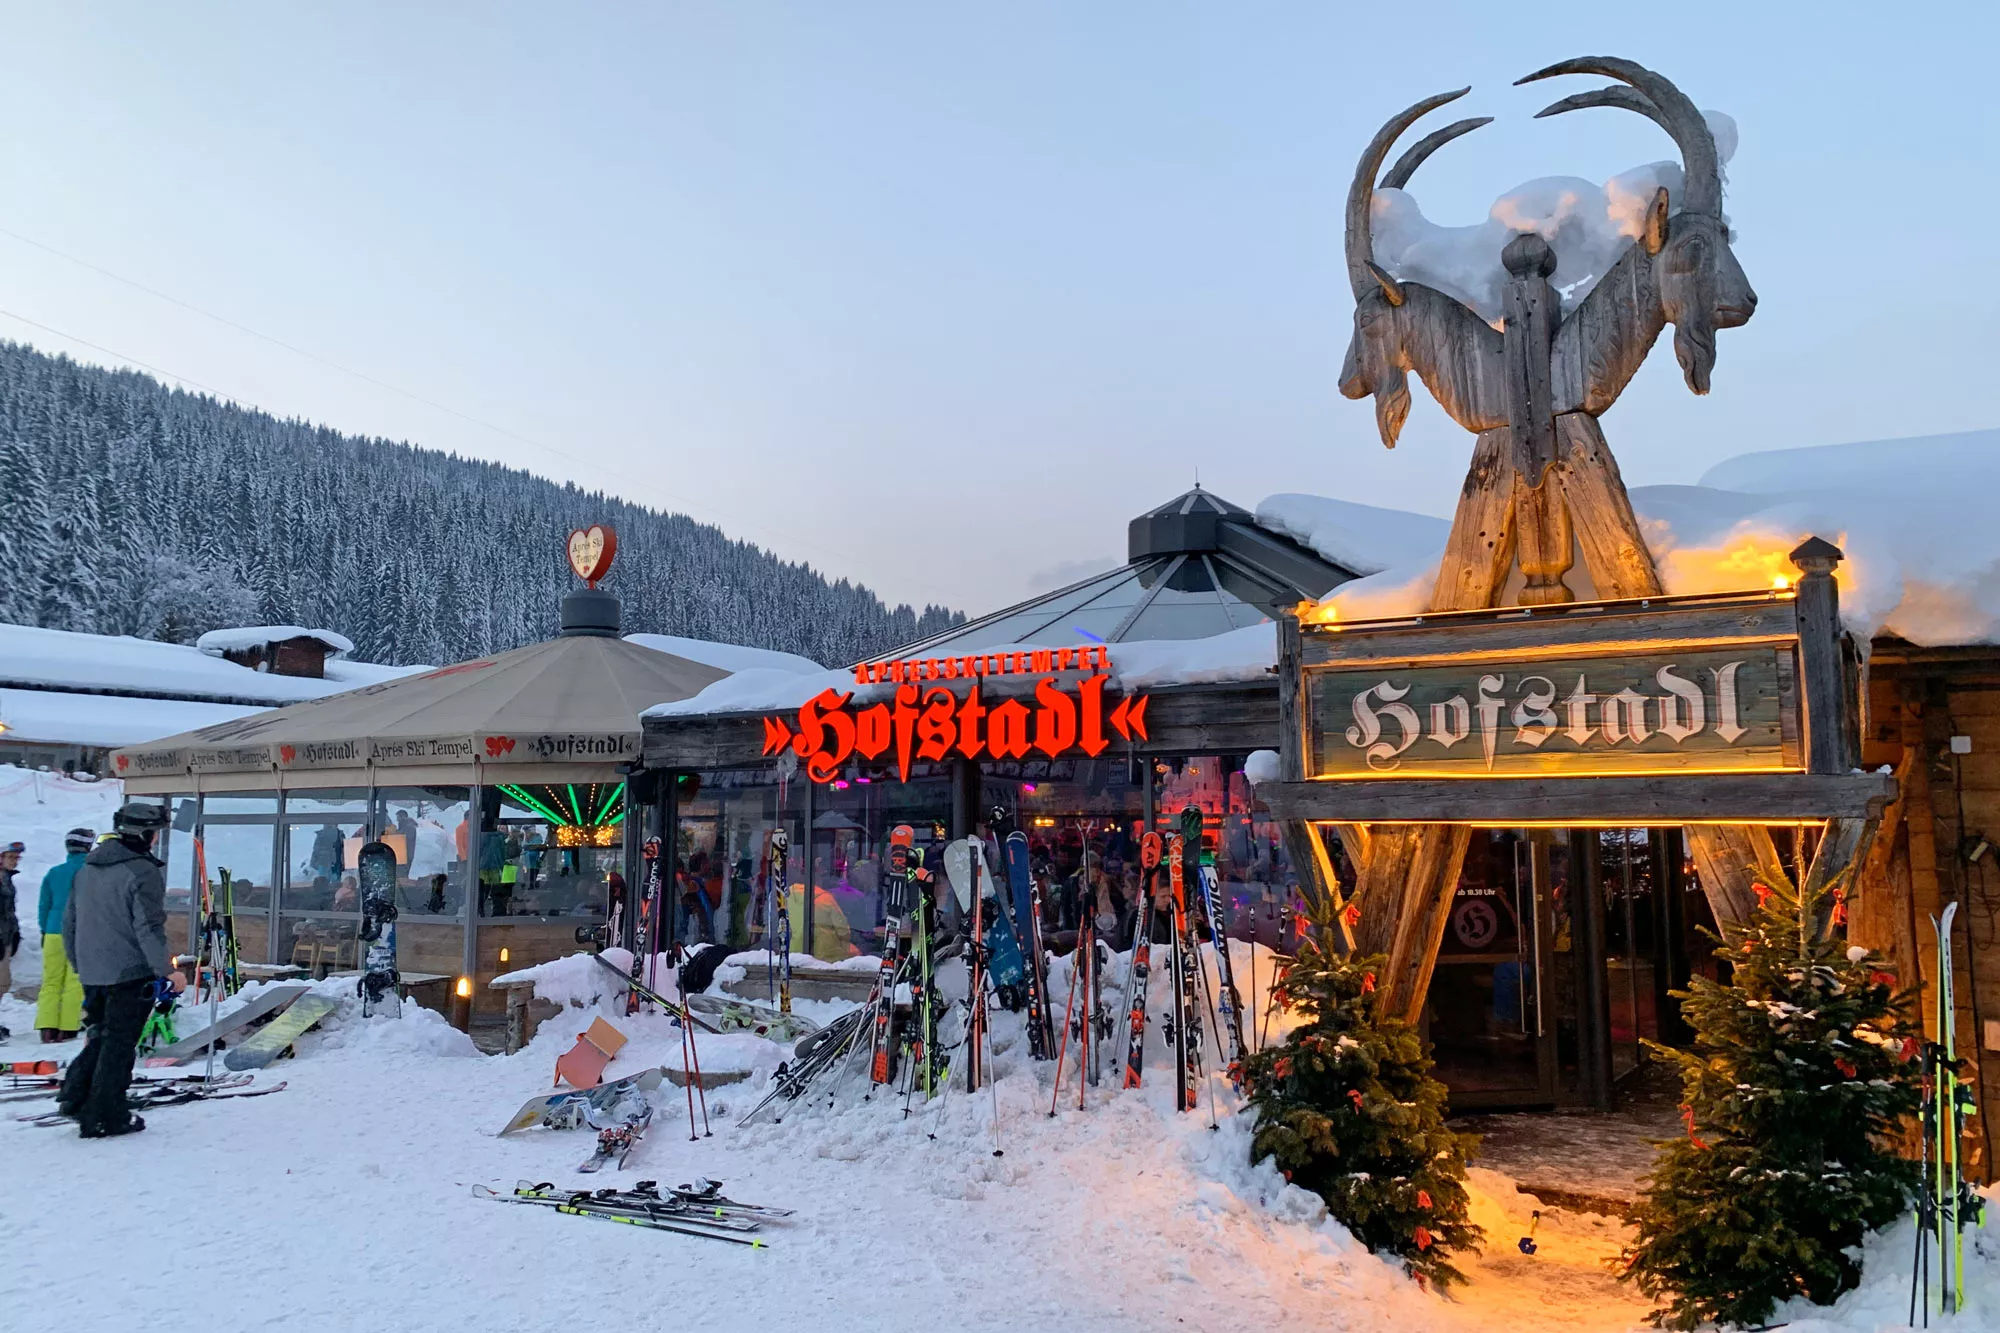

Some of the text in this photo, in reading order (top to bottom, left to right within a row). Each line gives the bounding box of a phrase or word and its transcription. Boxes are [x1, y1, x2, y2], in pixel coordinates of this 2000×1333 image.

[855, 645, 1113, 685] APRESSKITEMPEL
[1345, 660, 1750, 772] Hofstadl
[217, 750, 234, 764] Ski
[234, 748, 272, 766] Tempel
[406, 740, 426, 756] Ski
[428, 738, 474, 759] Tempel
[1483, 888, 1496, 896] Uhr
